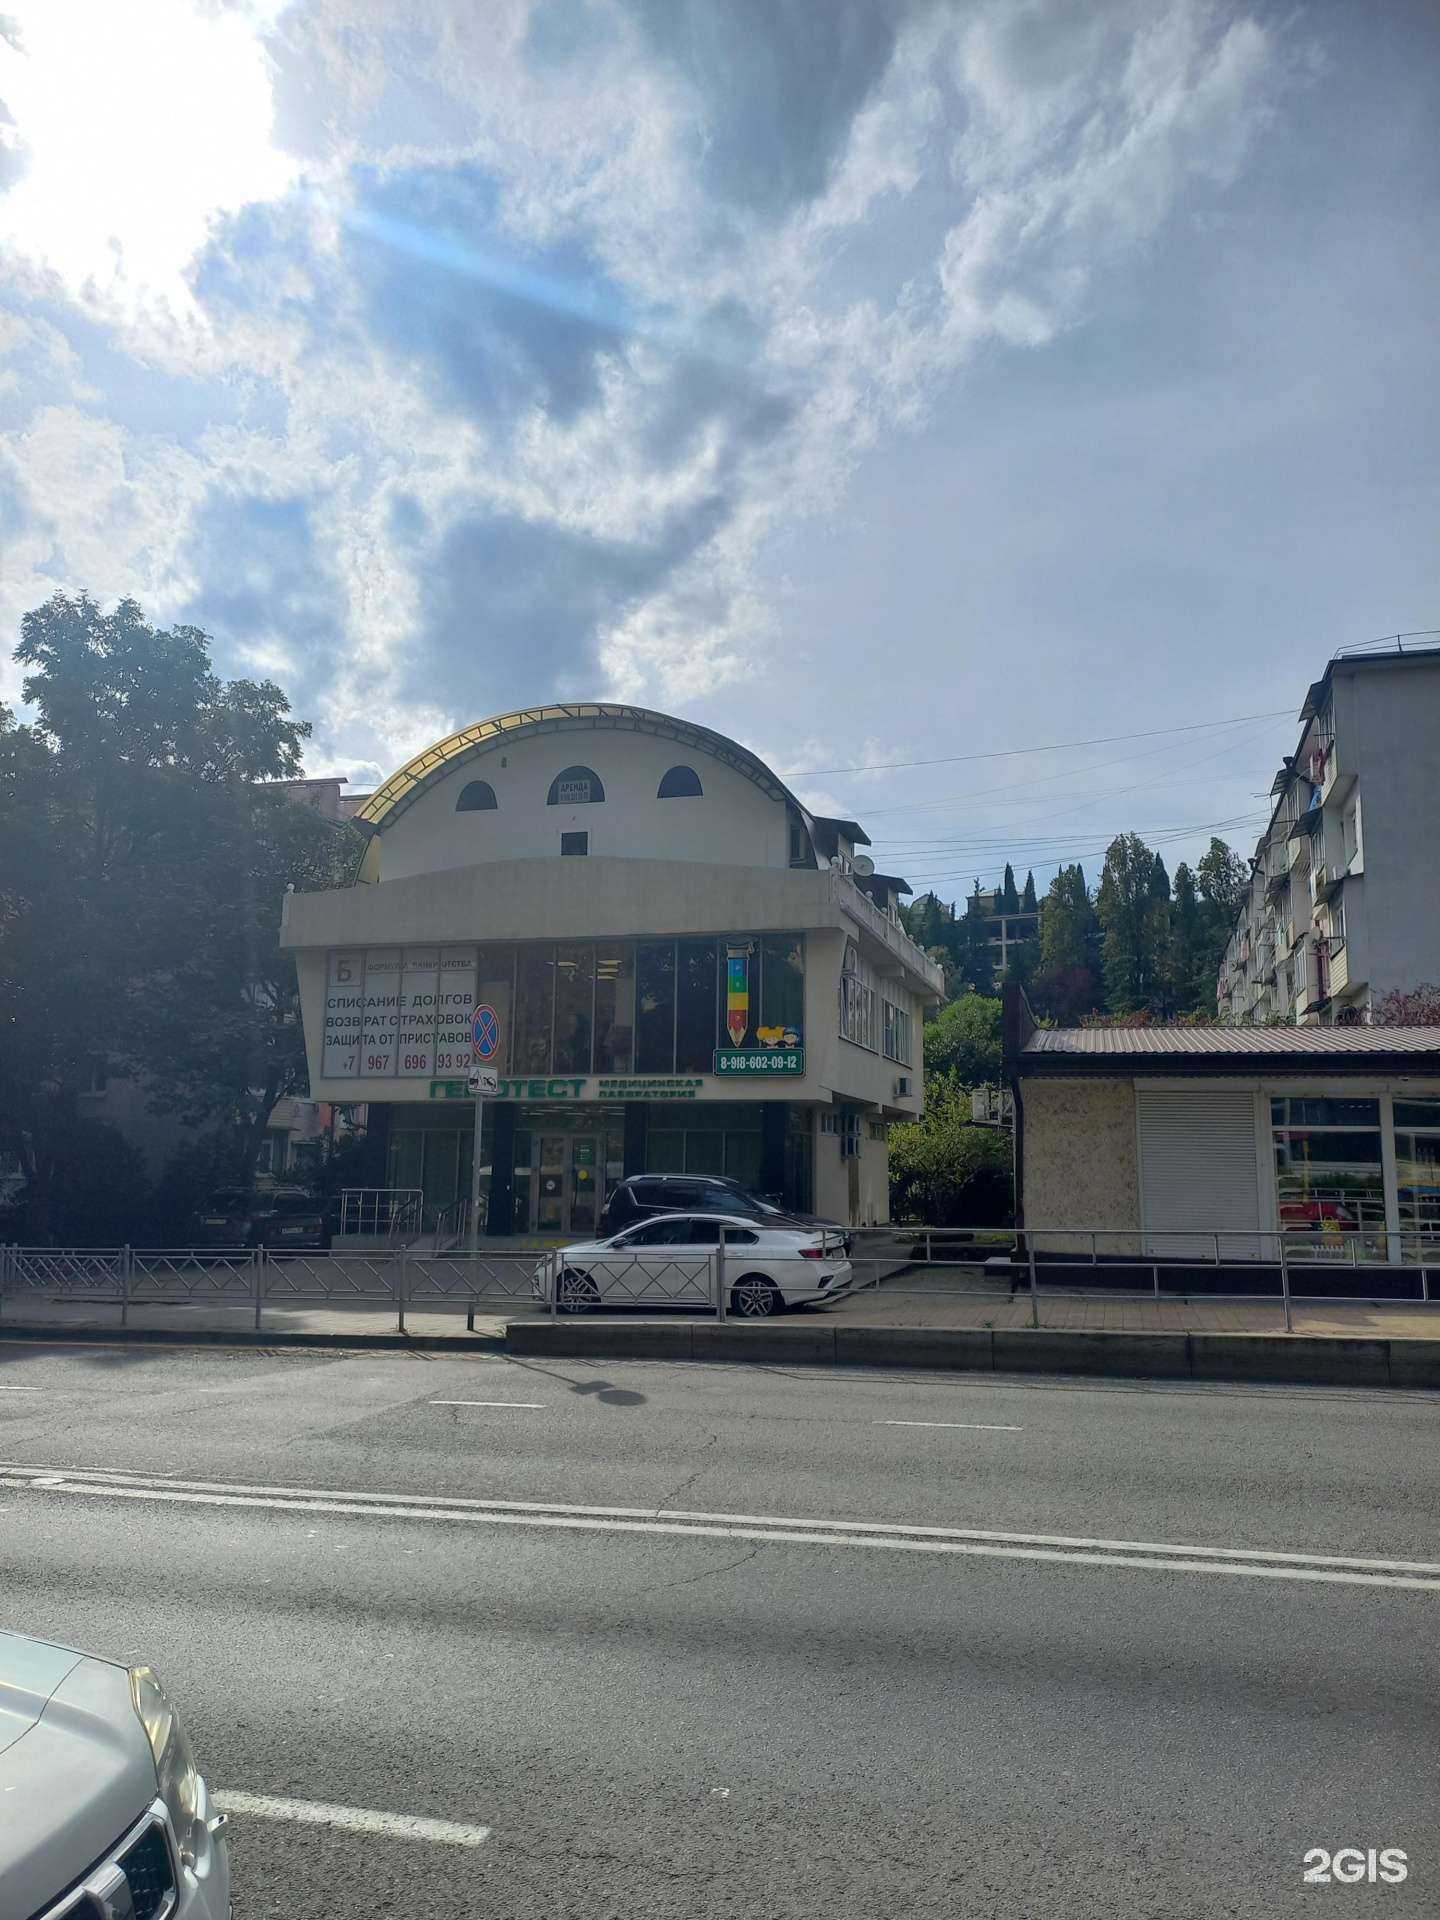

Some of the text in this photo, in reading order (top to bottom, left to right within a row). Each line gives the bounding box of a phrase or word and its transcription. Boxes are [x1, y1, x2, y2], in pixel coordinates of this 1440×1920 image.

[327, 994, 472, 1009] СПИСАНИЕ ДОЛГОВ
[326, 1013, 473, 1028] ВОЗВРАТ СТРАХОВОК
[326, 1031, 472, 1047] ЗАЩИТА ОТ ПРИСТАВОВ
[343, 1053, 470, 1071] +7 967 696 93 92
[720, 1055, 798, 1069] 8-918-602-09-12
